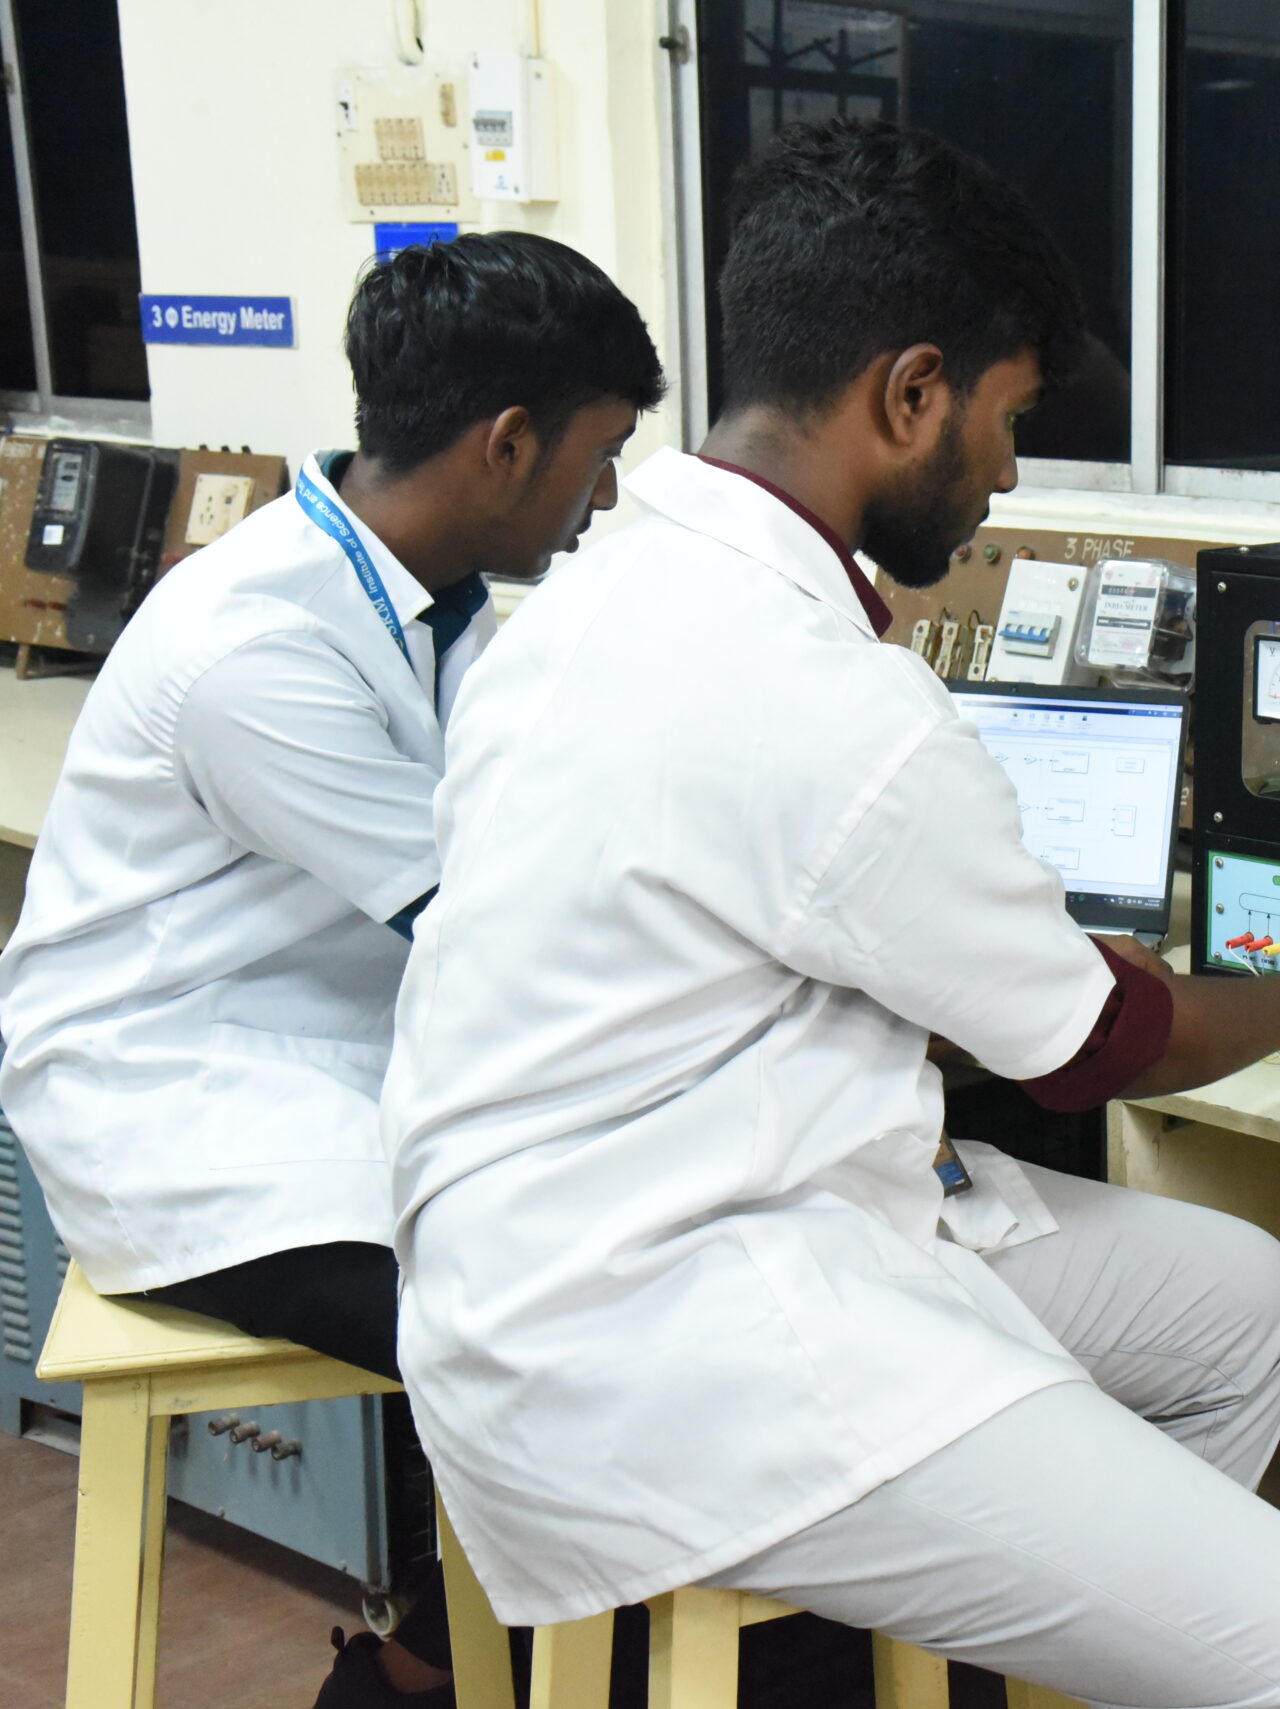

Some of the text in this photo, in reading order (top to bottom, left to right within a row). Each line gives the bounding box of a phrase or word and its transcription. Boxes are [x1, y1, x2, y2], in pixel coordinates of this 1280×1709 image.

[152, 305, 163, 328] 3
[181, 305, 236, 335] Energy
[240, 306, 285, 330] Meter
[304, 489, 318, 505] and
[316, 501, 351, 537] Science
[346, 537, 358, 549] of
[1064, 538, 1078, 559] 3
[354, 550, 379, 594] Institute
